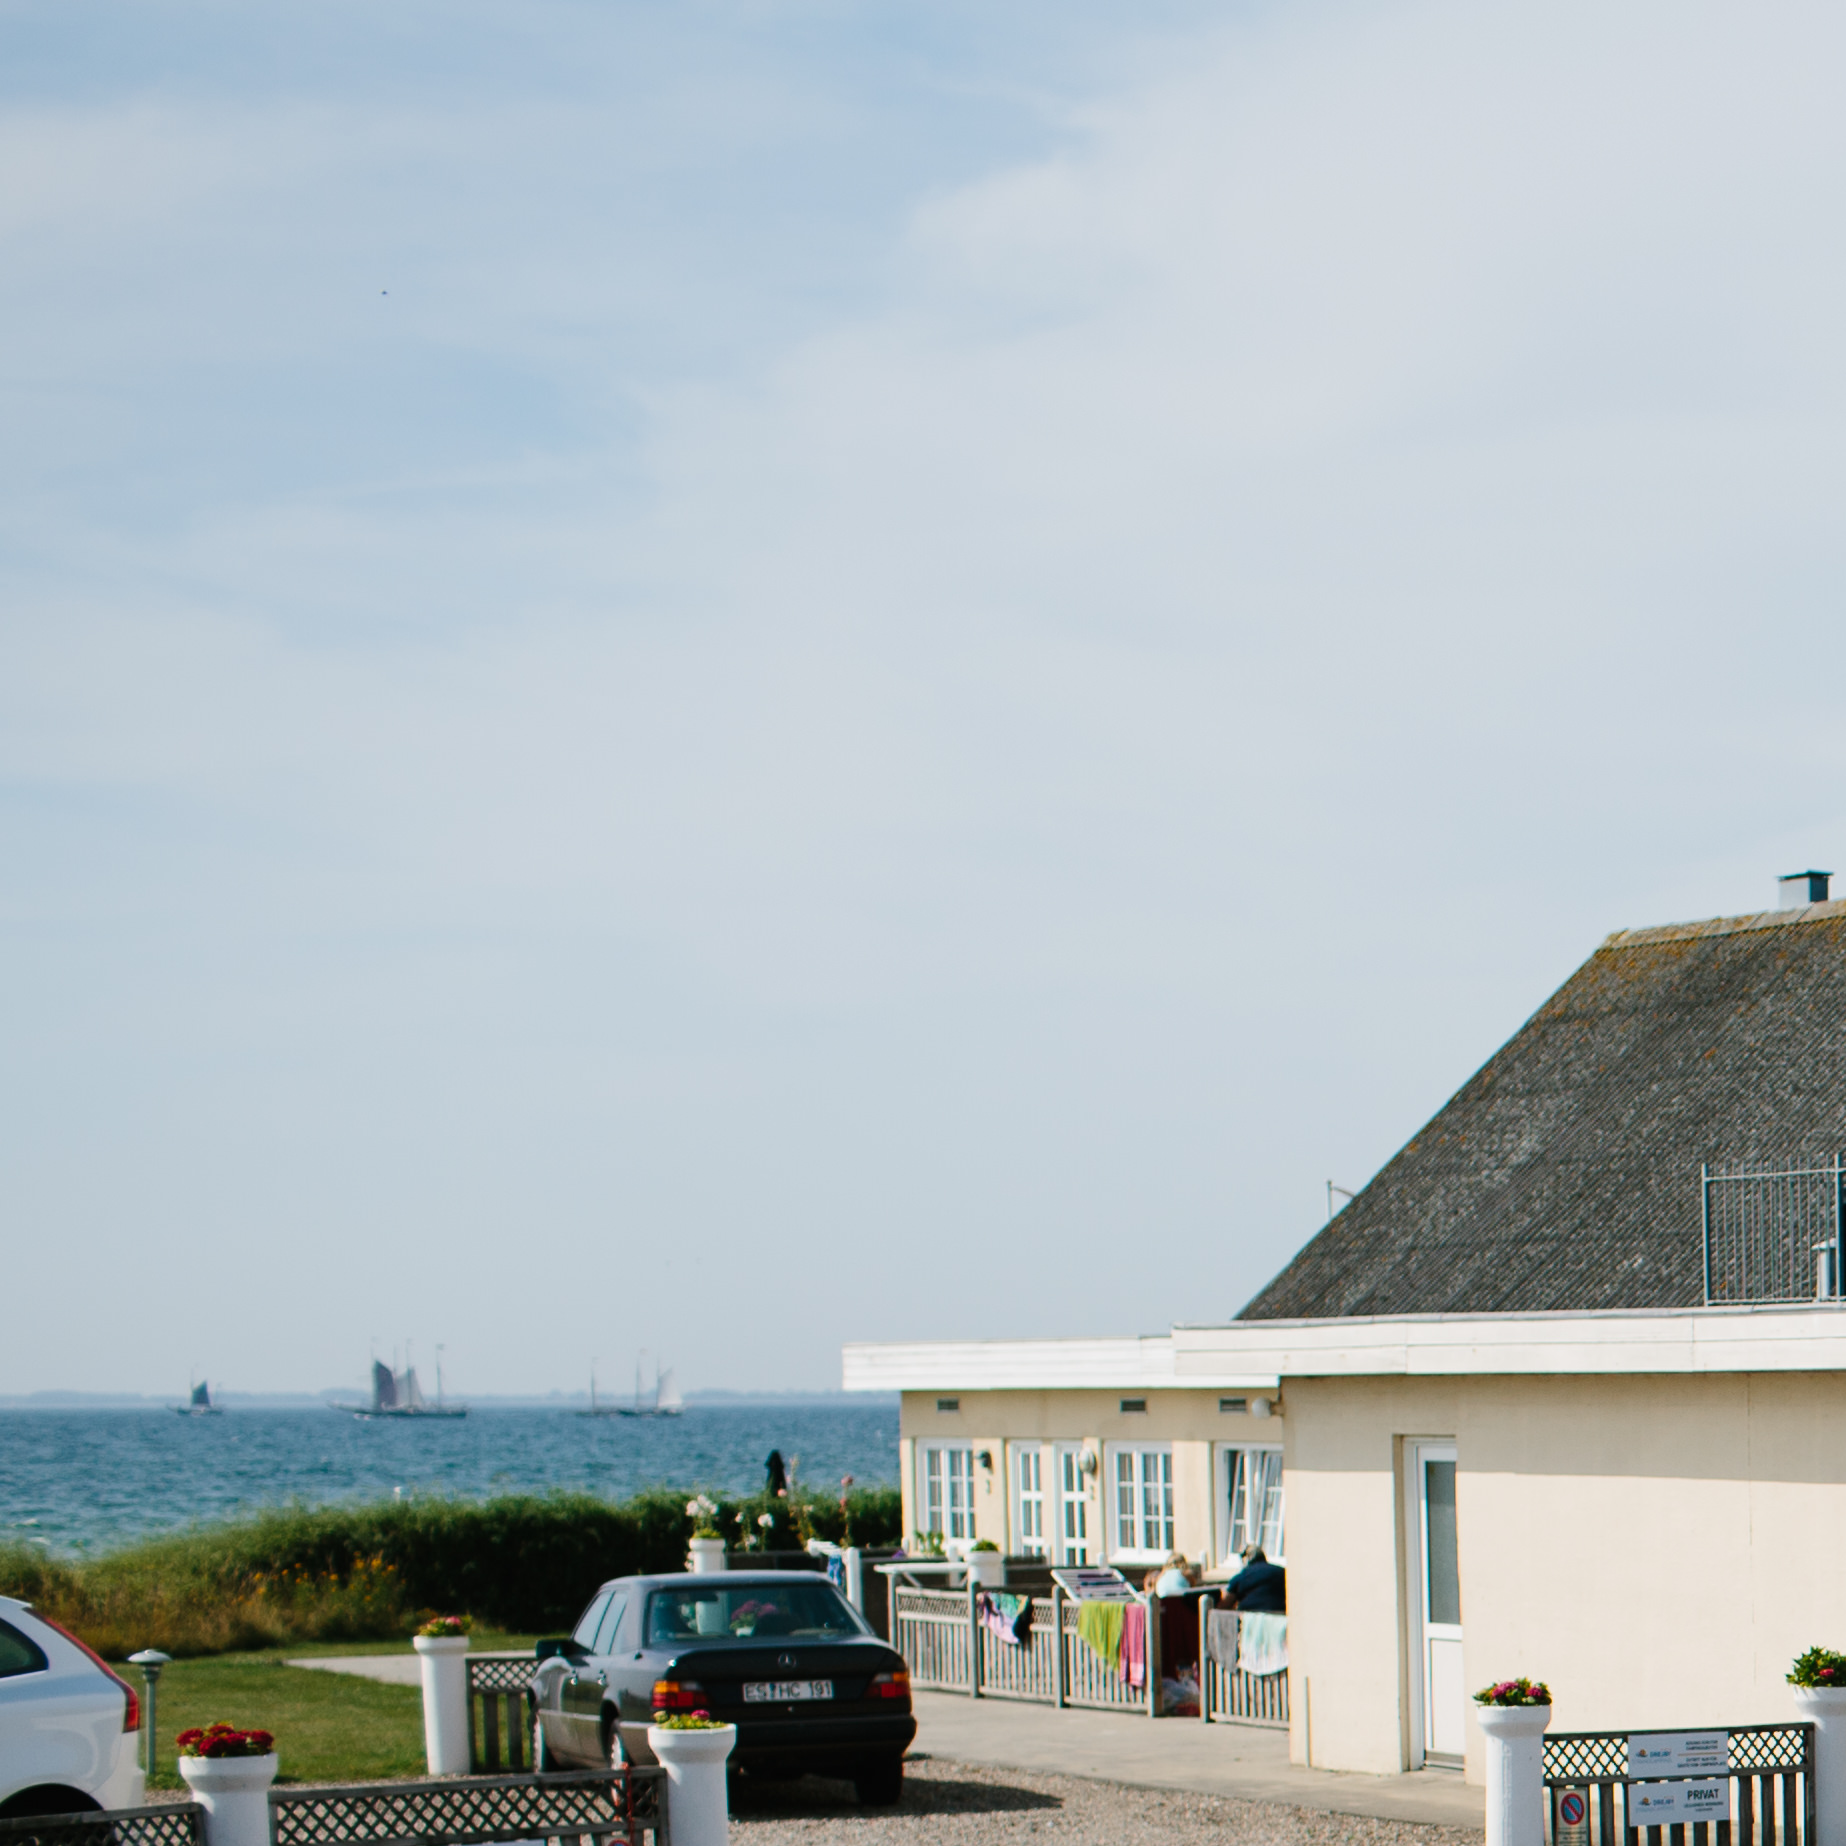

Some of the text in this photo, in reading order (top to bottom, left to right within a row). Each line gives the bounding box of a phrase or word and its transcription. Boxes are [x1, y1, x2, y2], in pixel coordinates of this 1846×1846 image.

[744, 1680, 832, 1701] ES HC 191
[1687, 1788, 1720, 1801] PRIVAT
